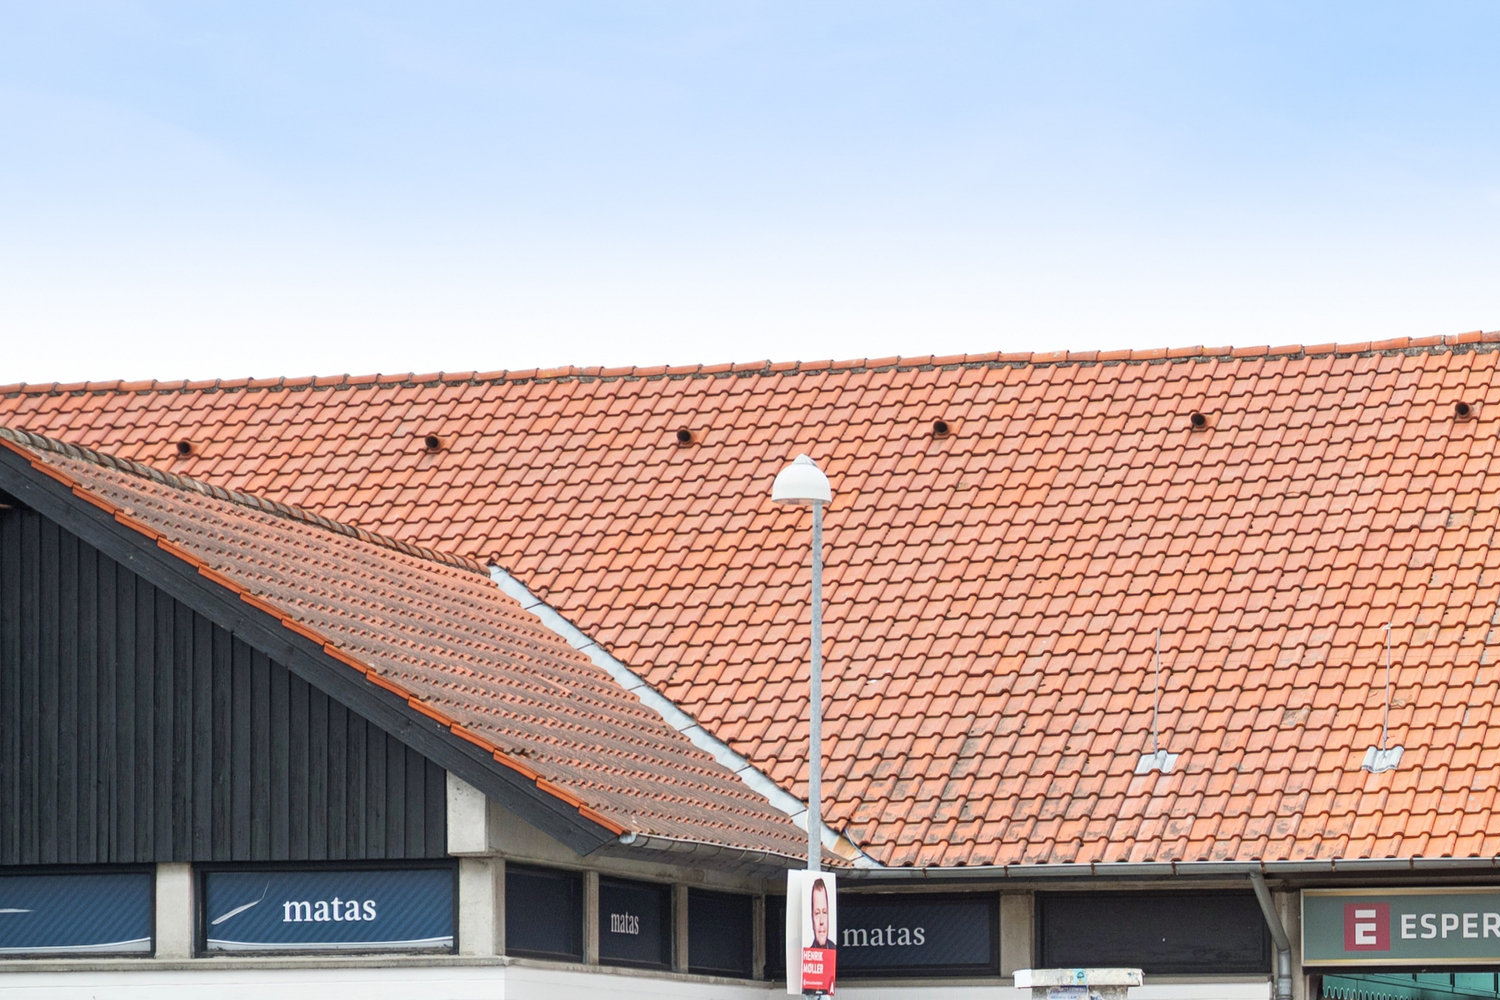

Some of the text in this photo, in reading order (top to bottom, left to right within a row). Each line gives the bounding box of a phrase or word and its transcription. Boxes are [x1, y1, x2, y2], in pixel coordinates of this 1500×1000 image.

[282, 896, 377, 922] matas
[610, 911, 639, 935] matas
[842, 924, 925, 947] matas
[803, 950, 824, 961] HENRIK
